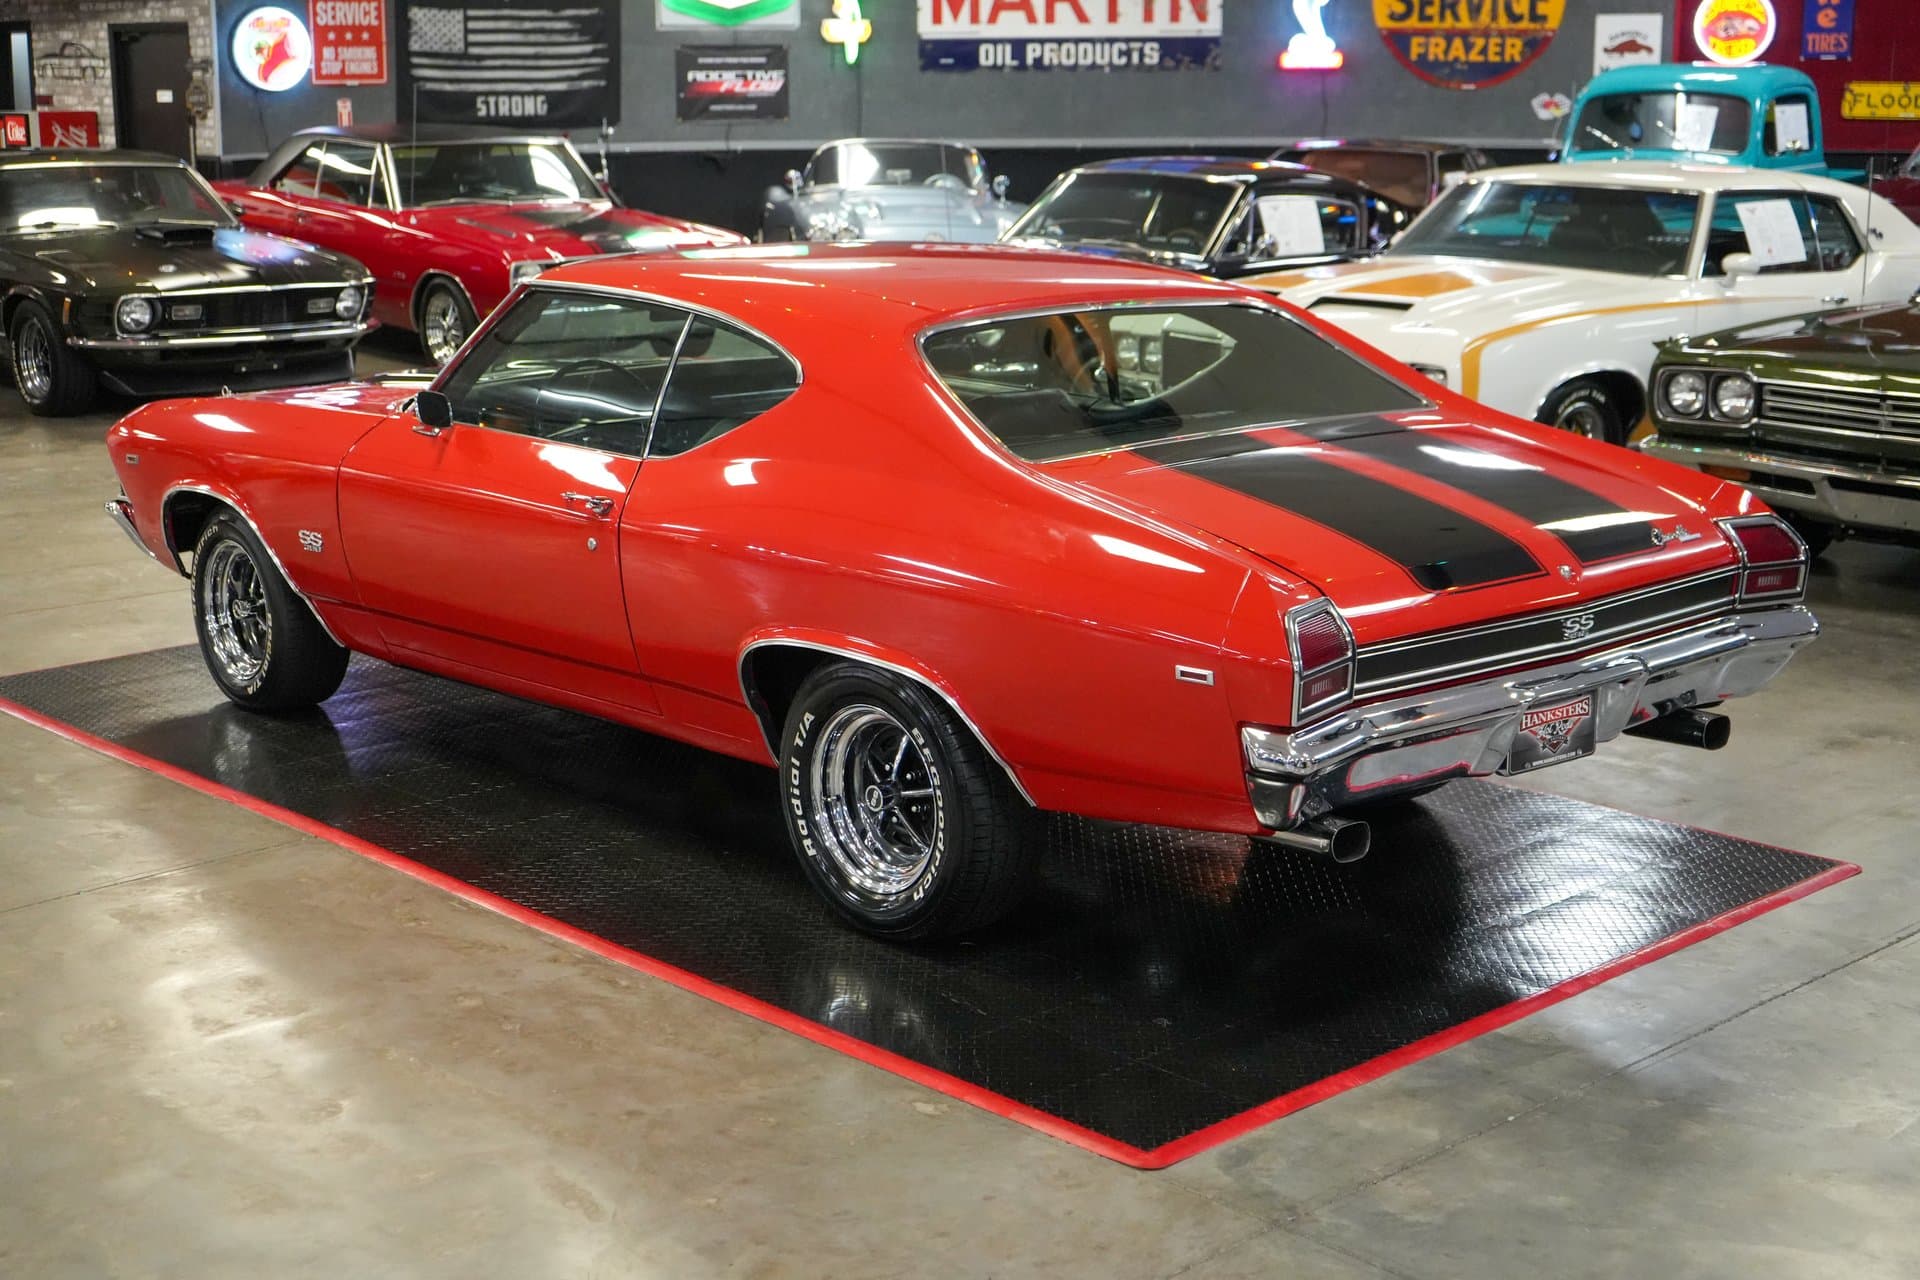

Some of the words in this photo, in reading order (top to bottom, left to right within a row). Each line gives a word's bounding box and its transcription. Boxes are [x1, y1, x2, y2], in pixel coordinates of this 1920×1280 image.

[316, 1, 379, 26] SERVICE
[1388, 0, 1549, 23] SERVICE
[1409, 36, 1524, 63] FRAZER
[1806, 32, 1848, 53] TIRES
[978, 43, 1019, 67] OIL
[1025, 42, 1160, 66] PRODUCTS
[719, 80, 786, 94] FLOW
[476, 95, 549, 117] STRONG
[7, 121, 27, 142] Coke
[298, 529, 324, 548] SS
[1566, 614, 1595, 633] SS
[1522, 699, 1589, 729] HANKSTERS
[793, 711, 815, 748] T/A
[790, 756, 817, 857] Radial
